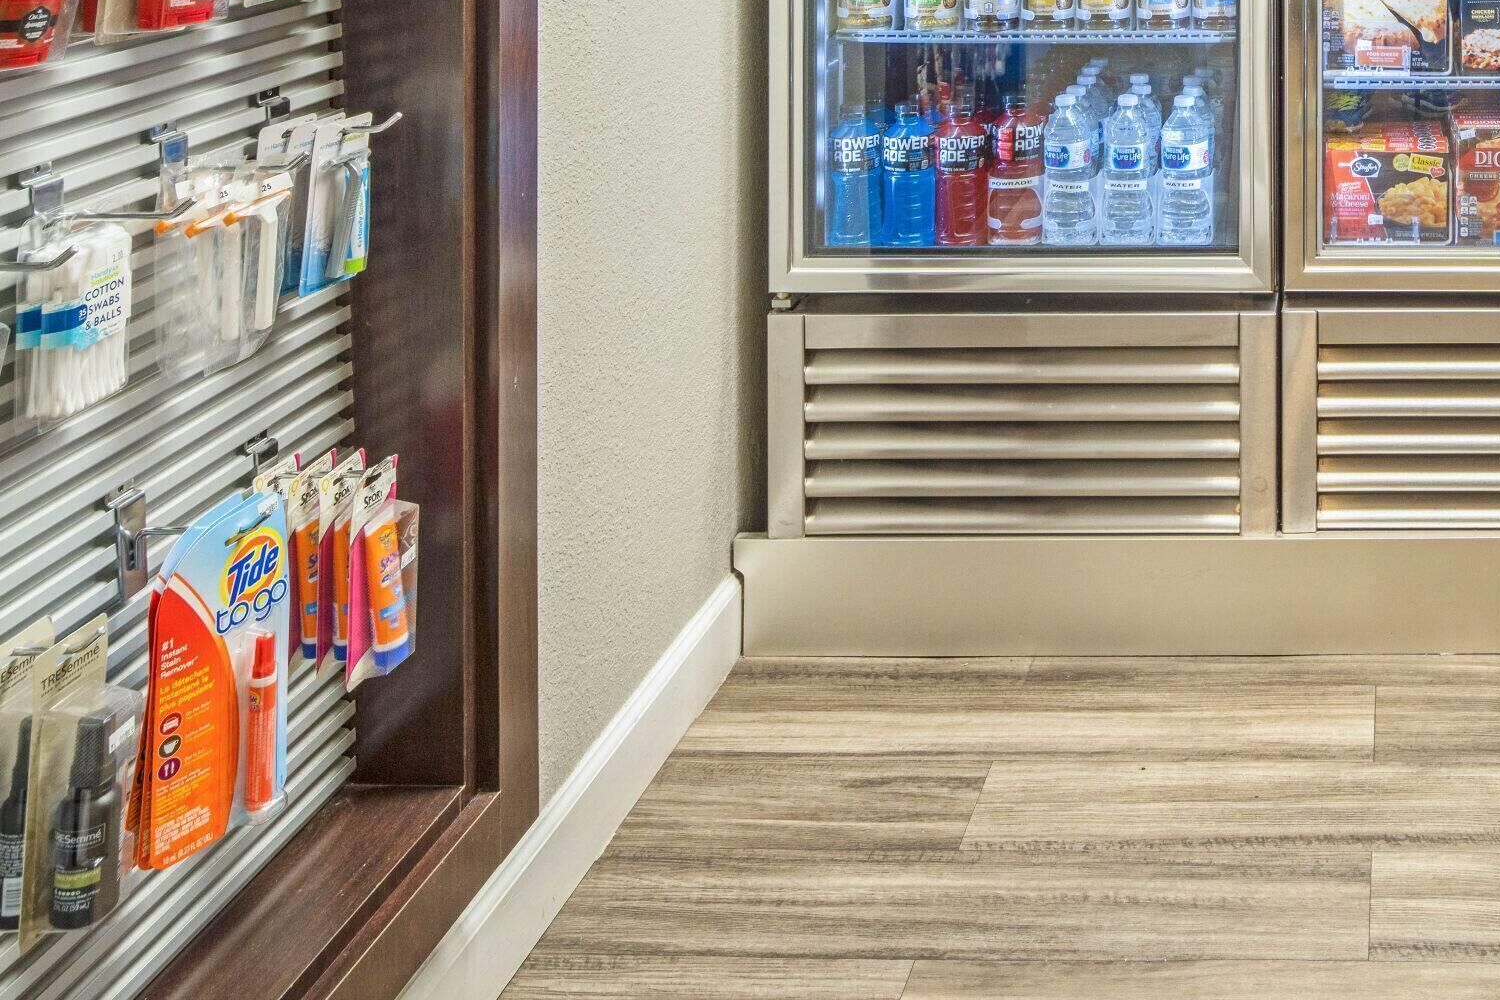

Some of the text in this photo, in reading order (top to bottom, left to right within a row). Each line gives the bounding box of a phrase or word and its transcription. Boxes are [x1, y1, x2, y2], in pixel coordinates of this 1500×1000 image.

[834, 135, 880, 151] POWER
[884, 137, 928, 150] POWER
[940, 135, 985, 150] POWER
[1056, 152, 1070, 161] Life
[1112, 152, 1142, 162] Pure Life
[1163, 152, 1190, 161] Pure Life
[1411, 157, 1441, 167] Classic
[261, 184, 272, 192] .25
[85, 276, 125, 302] COTTON
[88, 293, 120, 315] SWABS
[94, 306, 122, 327] BALLS
[227, 543, 280, 607] Tide
[216, 579, 287, 634] to go
[161, 638, 174, 651] #1
[161, 644, 188, 660] Instant
[40, 643, 100, 691] TRESemmé
[160, 656, 181, 670] Stain
[159, 701, 176, 714] plus
